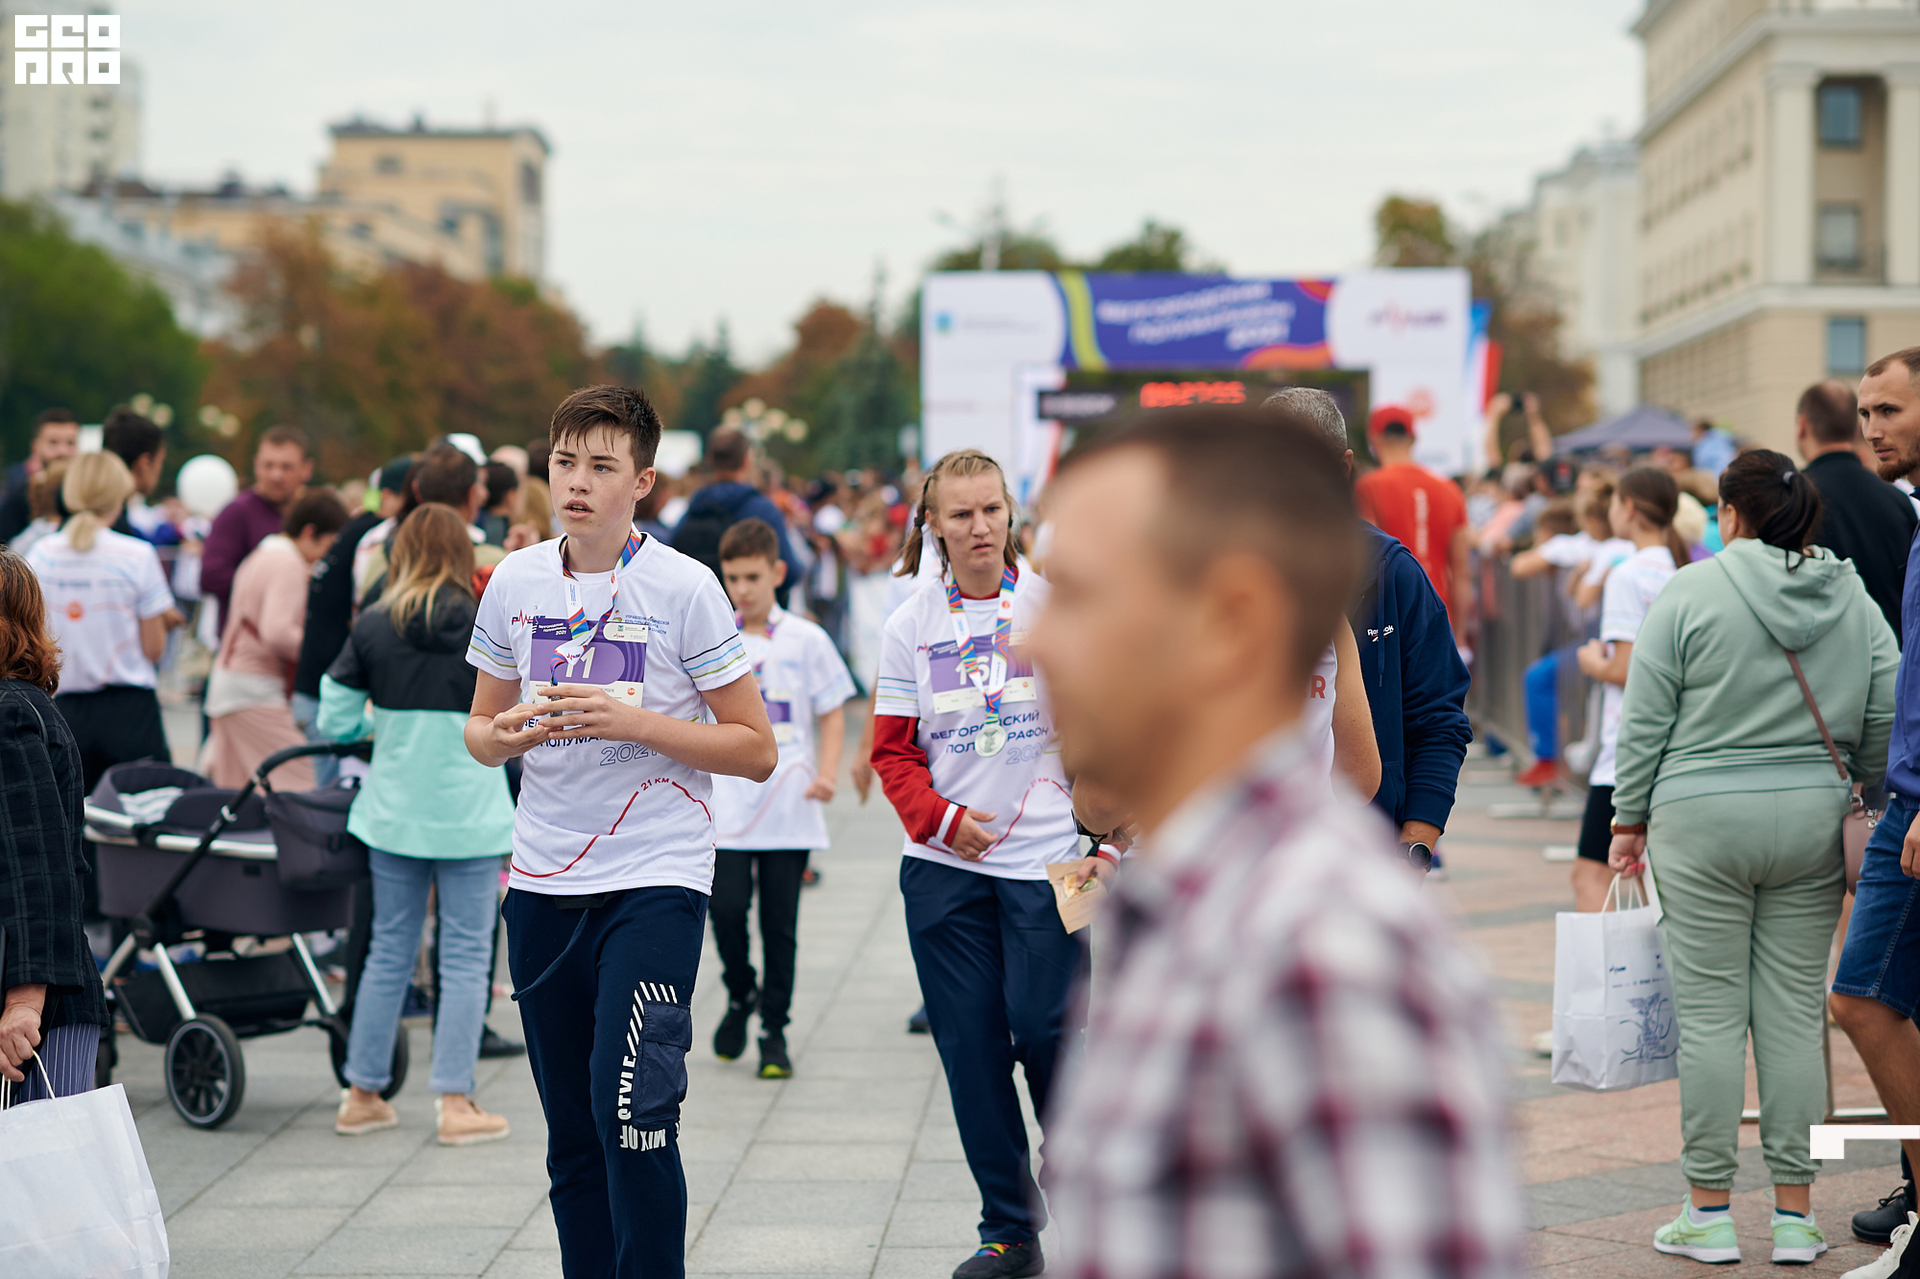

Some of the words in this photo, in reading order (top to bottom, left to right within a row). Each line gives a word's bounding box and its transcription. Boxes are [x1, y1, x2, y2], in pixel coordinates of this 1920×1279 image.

[930, 709, 1040, 740] БЕЛГОРСКИЙ
[946, 726, 1049, 754] ПОЛРАФОН
[600, 743, 657, 766] 202
[640, 779, 652, 791] 21
[619, 1124, 639, 1150] OF
[639, 1128, 667, 1152] MIX
